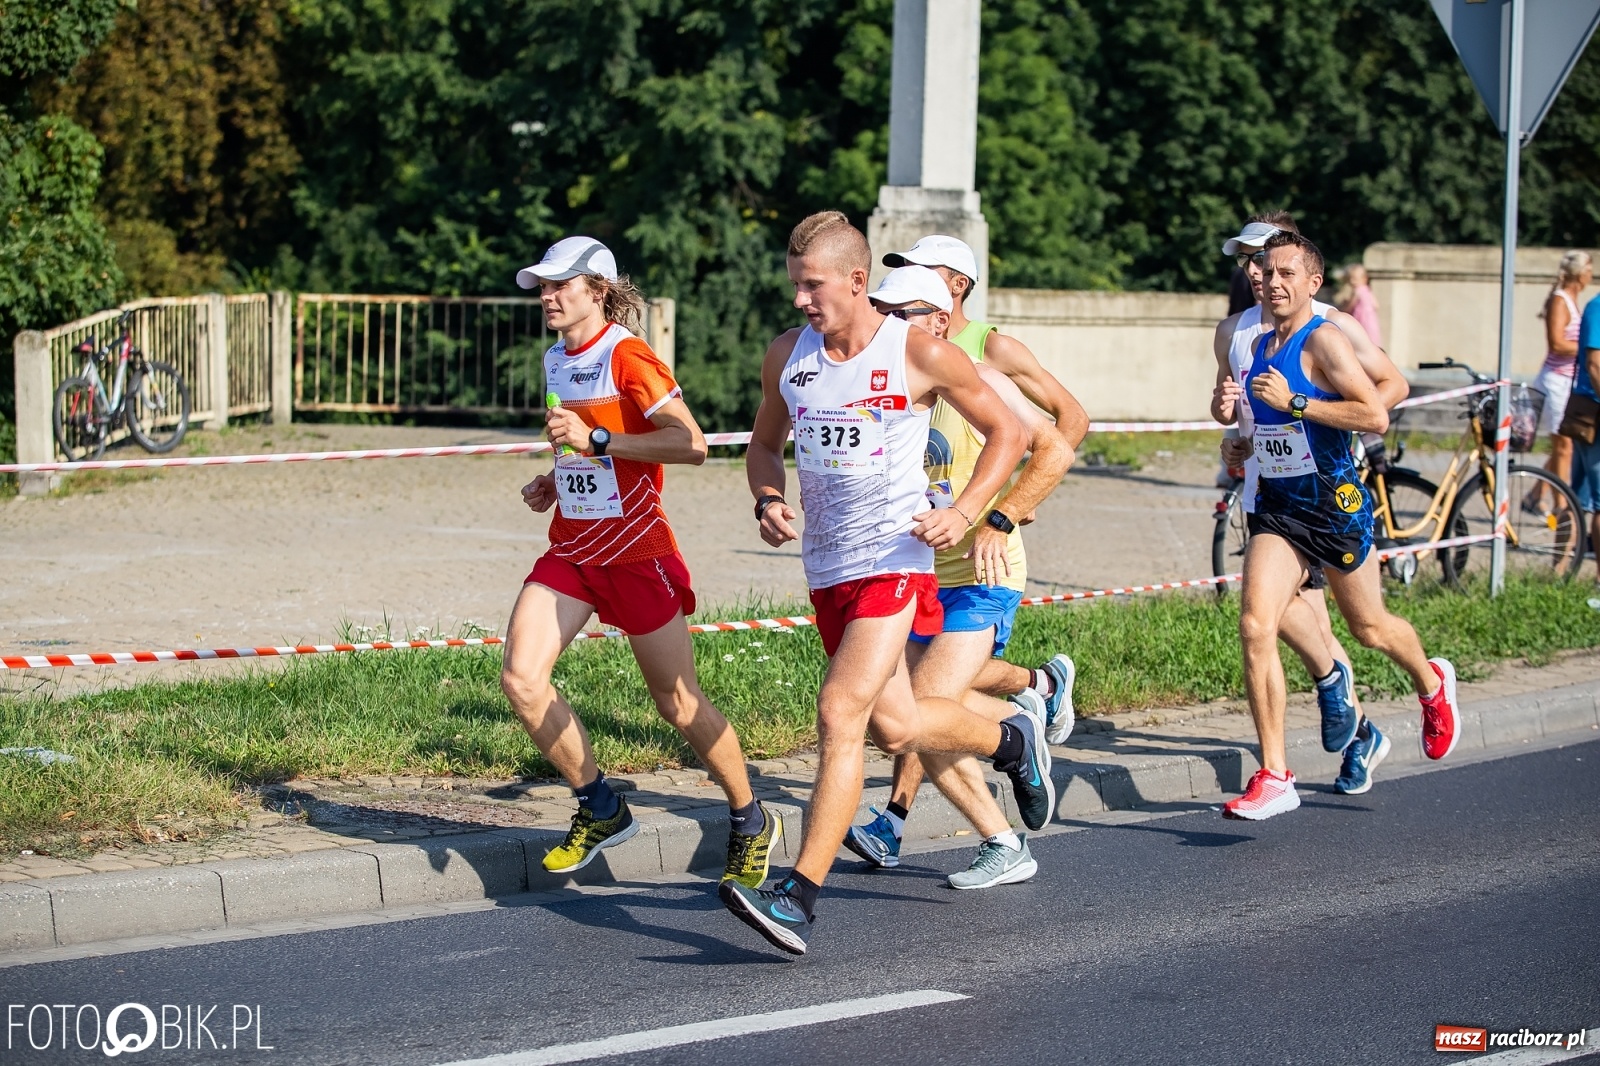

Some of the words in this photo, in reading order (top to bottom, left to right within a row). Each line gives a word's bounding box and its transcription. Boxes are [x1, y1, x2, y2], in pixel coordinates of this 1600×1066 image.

[789, 370, 819, 387] 4F
[850, 397, 894, 410] SKA
[820, 425, 861, 448] 373
[1266, 439, 1293, 457] 406
[566, 474, 598, 494] 285
[1338, 488, 1361, 509] Buff
